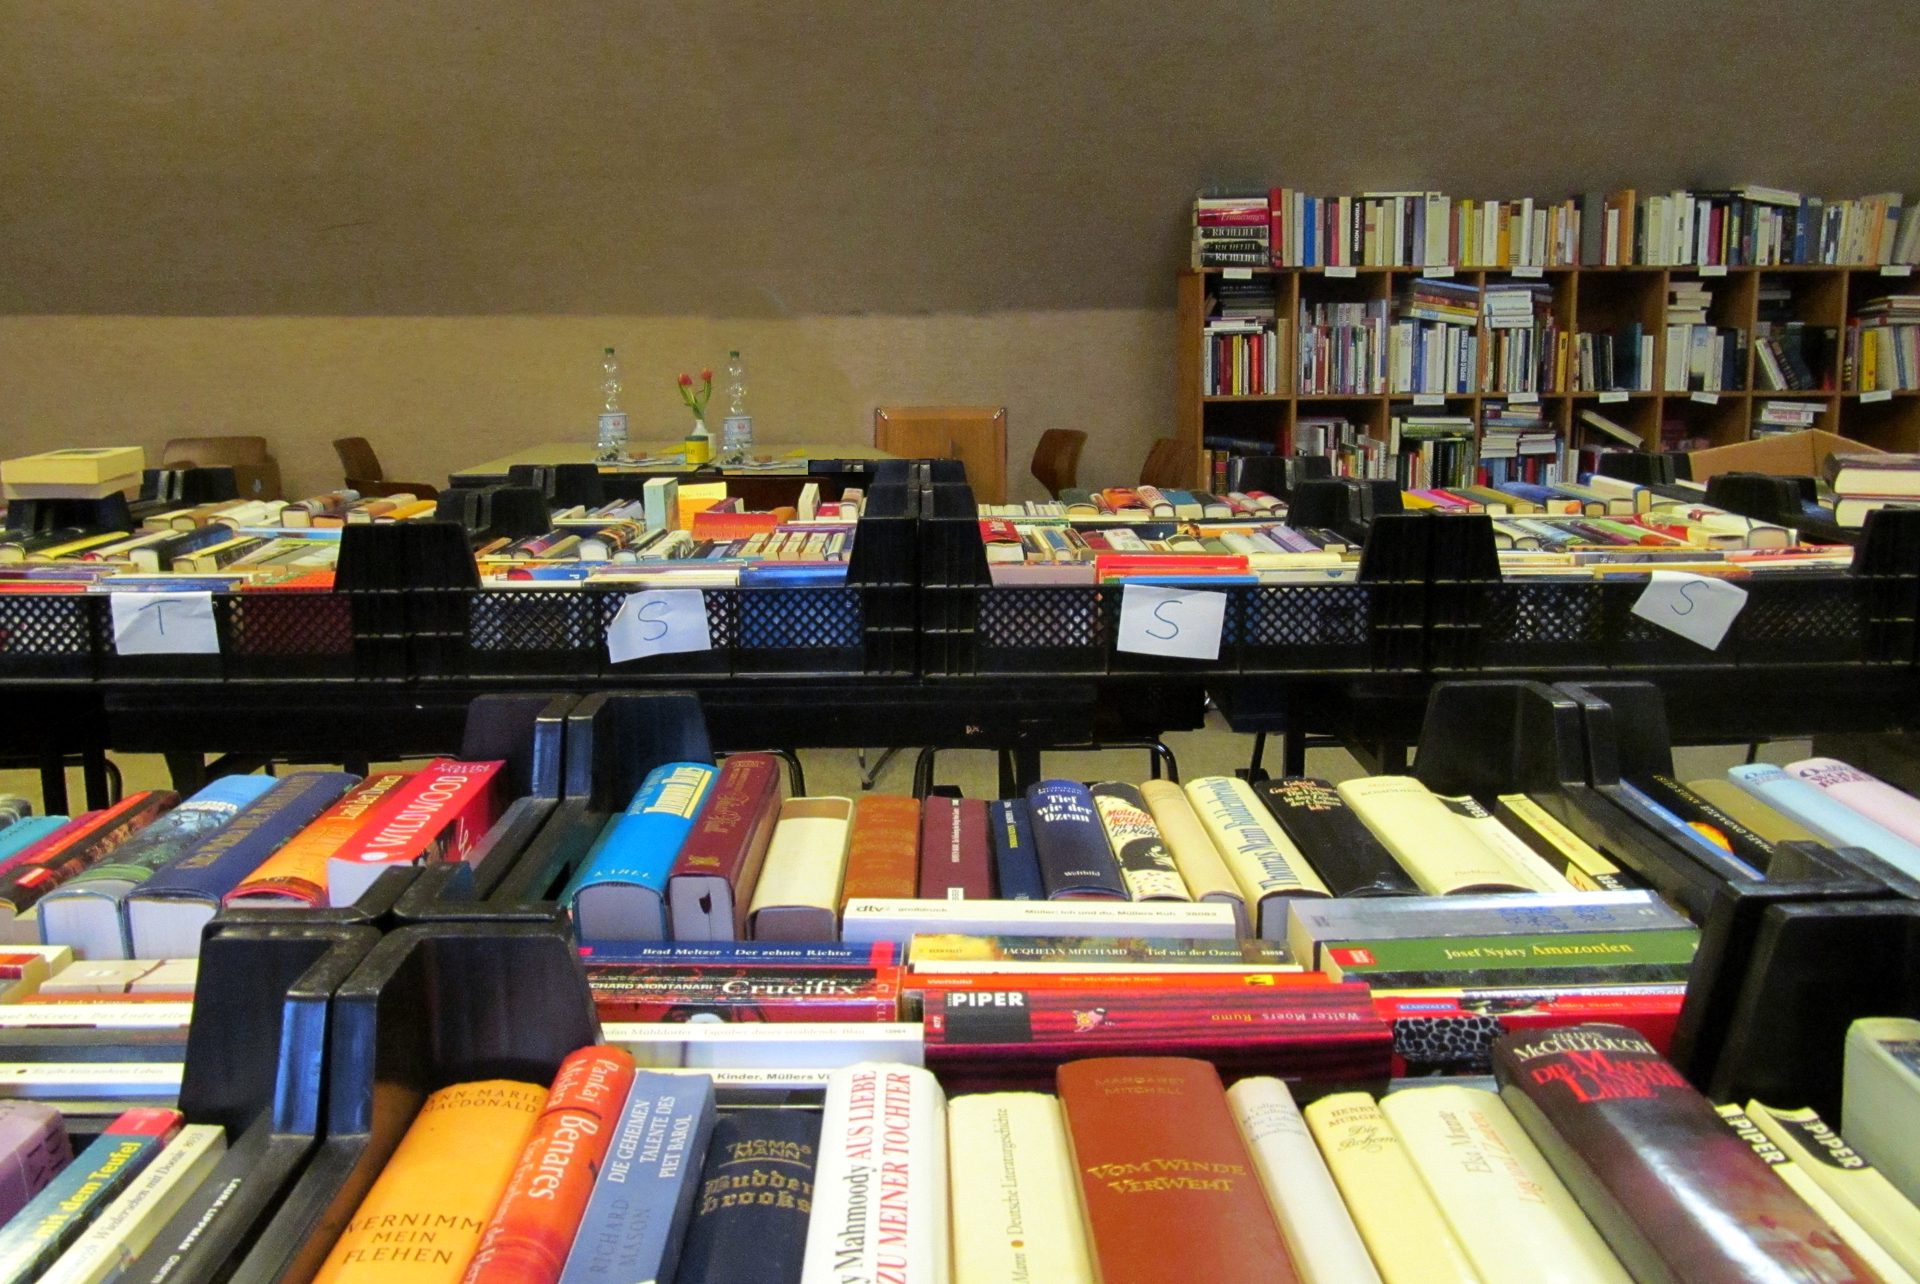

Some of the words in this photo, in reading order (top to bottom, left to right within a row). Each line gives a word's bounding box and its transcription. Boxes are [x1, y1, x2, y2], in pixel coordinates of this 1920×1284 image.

[1669, 580, 1710, 616] S
[637, 600, 669, 641] S
[1145, 599, 1183, 640] S
[1036, 804, 1063, 815] wie
[1067, 803, 1093, 816] der
[1047, 794, 1078, 804] Tief
[364, 776, 469, 848] WILDWOOD
[1044, 812, 1090, 823] Ozean
[1237, 827, 1279, 855] Mann
[1254, 851, 1302, 890] Thomas
[761, 948, 802, 956] zehnte
[806, 949, 853, 957] Richter
[1003, 948, 1066, 956] JACQUELYN
[1068, 948, 1128, 956] MITCHARD
[1145, 948, 1167, 957] Tief
[1169, 949, 1187, 957] wie
[1189, 949, 1207, 957] der
[1446, 948, 1481, 959] Josef
[1485, 947, 1527, 959] Nyáry
[1531, 942, 1634, 956] Amazonien
[588, 982, 634, 990] CHARD
[722, 980, 858, 996] Crucifix
[952, 992, 1025, 1007] PIPER
[1211, 1013, 1253, 1022] Rumo
[1262, 1012, 1306, 1022] Moers
[1312, 1011, 1361, 1021] Walter
[575, 1057, 620, 1104] Pankaj
[717, 1073, 764, 1082] Kinder,
[766, 1072, 814, 1081] Müllers
[1531, 1063, 1570, 1085] DIE
[848, 1070, 877, 1123] LIEBE
[882, 1072, 911, 1156] TOCHTER
[616, 1099, 651, 1161] GEHEIMEN
[639, 1116, 670, 1164] TALENTE
[655, 1095, 677, 1116] DES
[666, 1114, 693, 1152] BAROL
[1728, 1118, 1786, 1165] PIPER
[726, 1139, 812, 1156] THOMAS
[733, 1147, 800, 1161] MANN
[846, 1125, 874, 1161] AUS
[1803, 1122, 1864, 1169] PIPER
[528, 1114, 600, 1201] Benares
[658, 1152, 681, 1179] PIET
[1087, 1162, 1152, 1180] VOM
[1151, 1158, 1247, 1176] WINDE
[59, 1181, 103, 1212] dem
[87, 1141, 142, 1180] Teufel
[608, 1160, 631, 1184] DIE
[1107, 1176, 1234, 1195] VERWEHT
[834, 1161, 878, 1272] Mahmoody
[877, 1161, 909, 1249] MEINER
[1001, 1189, 1024, 1236] Deutsche
[346, 1213, 484, 1235] VERNIMM
[371, 1231, 437, 1244] MEIN
[342, 1246, 454, 1265] FLEHEN
